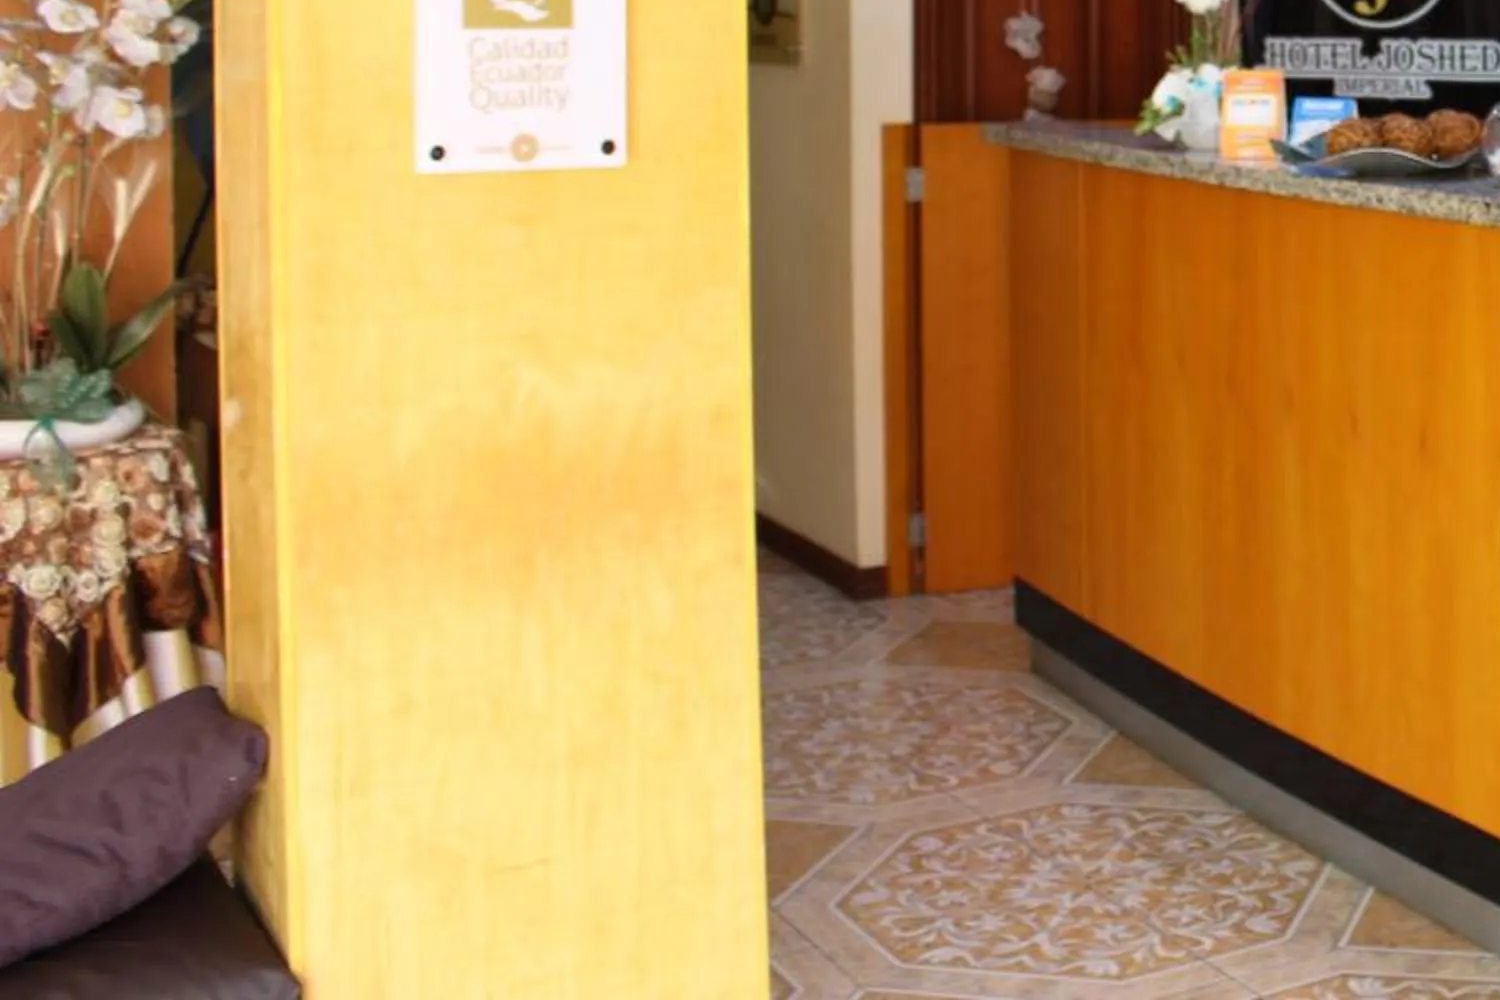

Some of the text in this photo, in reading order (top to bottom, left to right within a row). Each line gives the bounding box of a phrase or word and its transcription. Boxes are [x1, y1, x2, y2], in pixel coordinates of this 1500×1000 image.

[466, 35, 570, 60] Calidad
[1267, 41, 1369, 71] HOTEL
[469, 58, 566, 83] Ecuador
[468, 83, 571, 114] Quality
[1337, 79, 1427, 96] IMPERIAL
